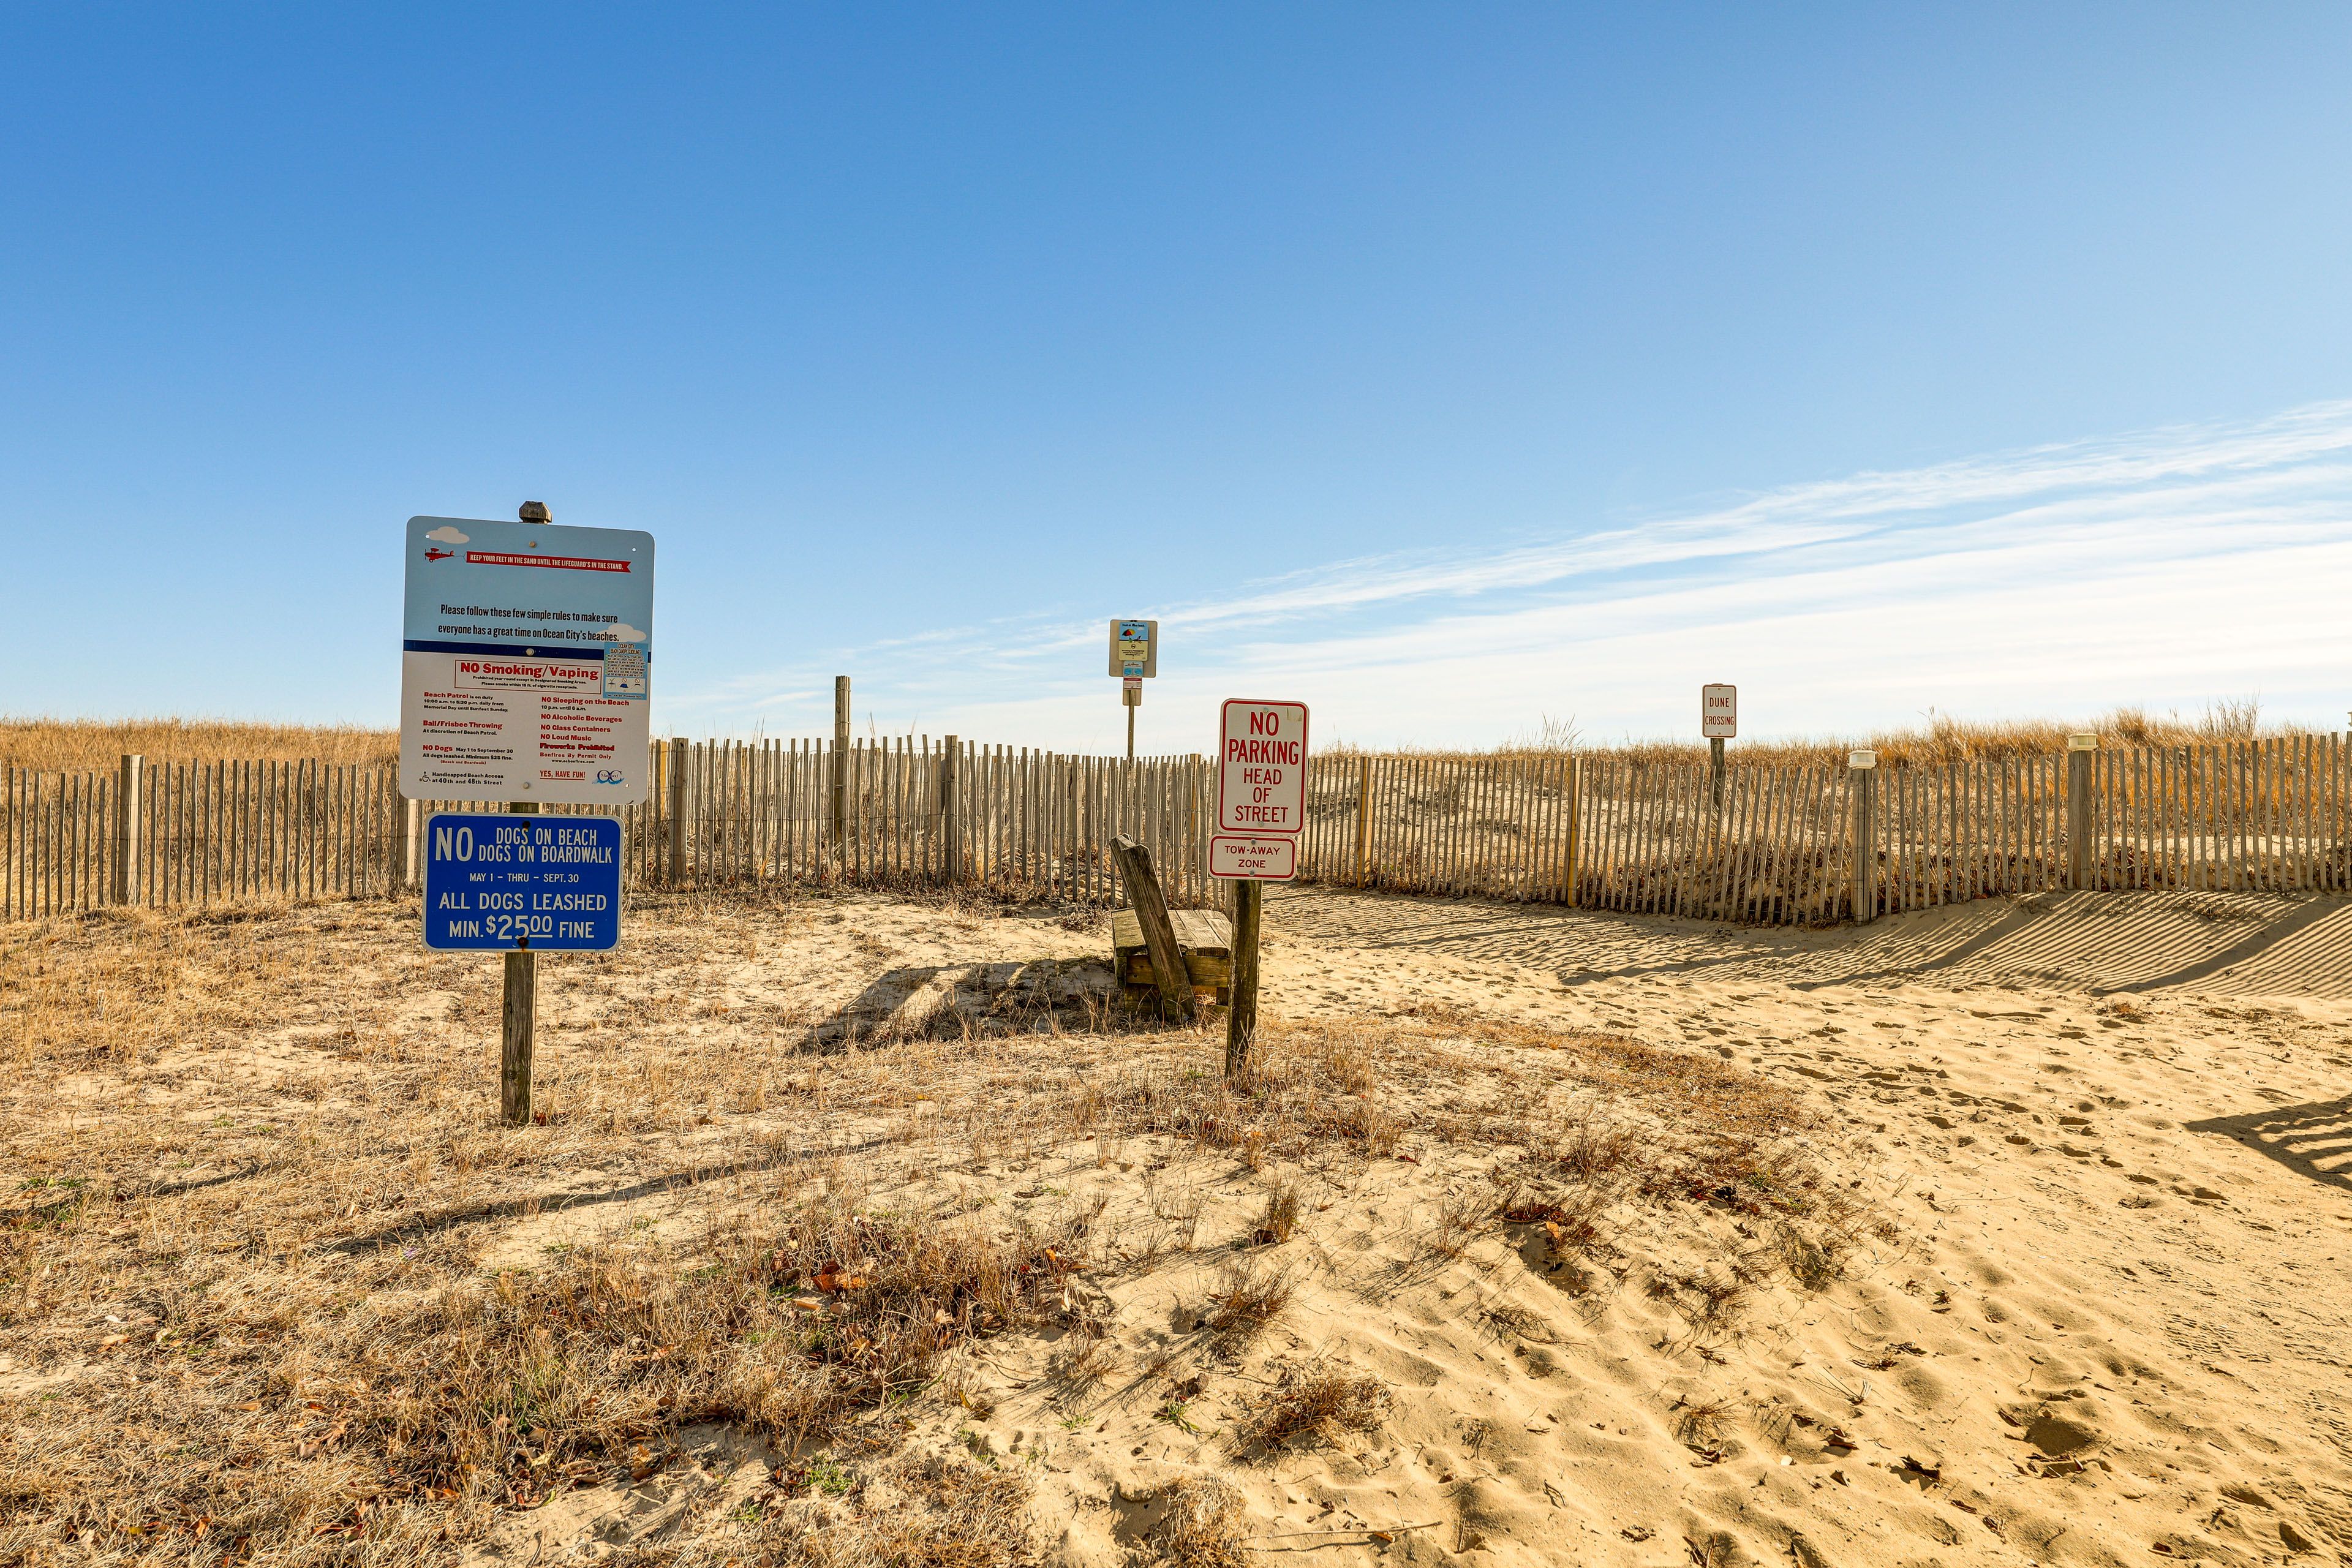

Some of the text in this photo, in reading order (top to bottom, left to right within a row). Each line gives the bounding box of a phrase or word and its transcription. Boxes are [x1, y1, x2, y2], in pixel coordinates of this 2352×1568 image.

[441, 605, 465, 614] Please
[467, 606, 489, 616] follow
[491, 607, 511, 617] these
[513, 608, 526, 618] few
[527, 609, 551, 621] simple
[552, 611, 570, 620] rules
[581, 612, 600, 622] make
[439, 625, 471, 635] everyone
[473, 625, 486, 635] has
[494, 628, 513, 638] great
[514, 627, 531, 637] time
[543, 628, 564, 639] Ocean
[566, 630, 586, 641] City's
[588, 631, 619, 641] beaches.
[461, 662, 598, 680] NO Smoking/Vaping
[1710, 698, 1729, 707] DUNE
[1250, 712, 1279, 736] NO
[1705, 716, 1734, 725] CROSSING
[1229, 739, 1298, 765] PARKING
[1244, 768, 1282, 785] HEAD
[1253, 787, 1272, 803] OF
[1235, 805, 1288, 823] STREET
[435, 827, 473, 861] NO
[496, 827, 597, 846] DOGS ON BEACH
[479, 845, 612, 863] DOGS ON BOARDWALK
[1225, 846, 1280, 855] TOW-AWAY
[1238, 859, 1266, 868] ZONE
[470, 873, 486, 881] MAY
[508, 873, 529, 882] THRU
[568, 874, 579, 883] 30
[439, 892, 606, 911] ALL DOGS LEASHED
[450, 921, 483, 938] MIN.
[559, 922, 594, 938] FINE
